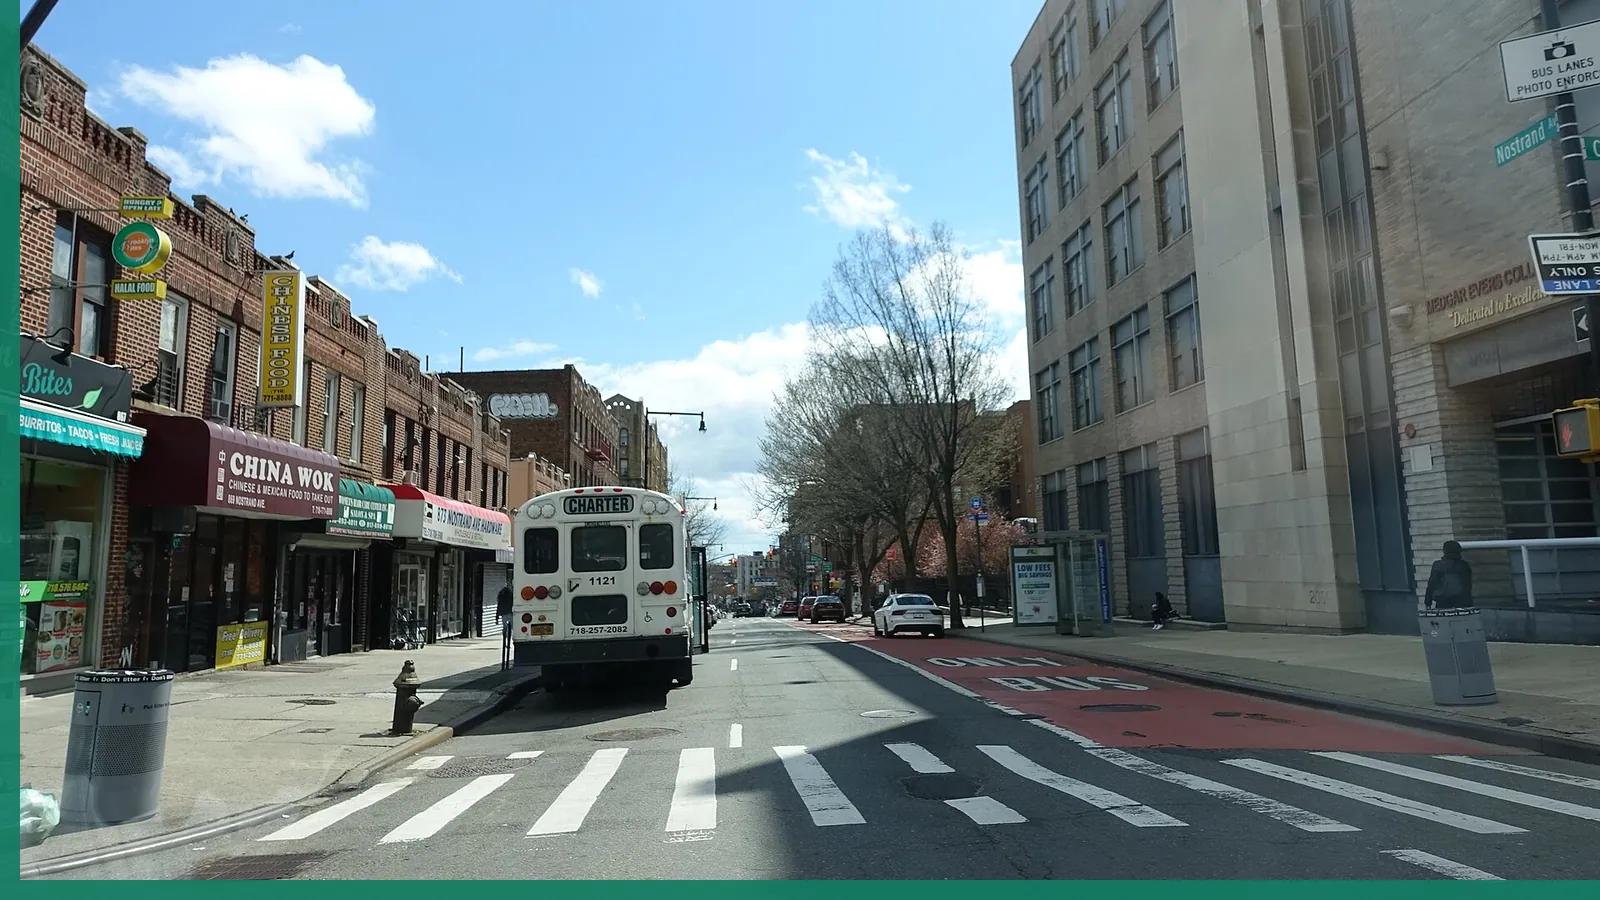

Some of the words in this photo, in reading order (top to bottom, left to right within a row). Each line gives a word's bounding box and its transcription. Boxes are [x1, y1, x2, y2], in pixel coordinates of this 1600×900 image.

[1532, 66, 1553, 79] BUS
[1557, 57, 1595, 74] LANES
[1517, 81, 1552, 95] PHOTO
[1556, 70, 1600, 88] ENFORC
[1496, 122, 1546, 164] Nostrand
[1559, 242, 1598, 251] MON-FRI
[1542, 253, 1586, 261] 4PM-7PM
[1550, 266, 1587, 277] ONLY
[114, 283, 136, 293] HALAL
[136, 282, 156, 293] FOOD
[1427, 287, 1467, 315] MEDGAR
[1468, 274, 1504, 300] EVERS
[1503, 261, 1535, 286] COLL
[1553, 280, 1591, 290] LANE
[270, 275, 294, 345] CHINESE
[1495, 299, 1505, 314] to
[268, 348, 291, 389] FOOD
[22, 362, 73, 396] Bites
[20, 414, 62, 434] BURRITOS
[67, 425, 94, 440] TACOS
[100, 432, 120, 446] FRESH
[230, 452, 294, 486] CHINA
[297, 466, 334, 492] WOK
[228, 479, 256, 494] CHINESE
[256, 486, 261, 494] &
[262, 485, 287, 498] MEXICAN
[288, 489, 303, 500] FOOD
[303, 491, 311, 501] TO
[311, 493, 323, 503] TAKE
[324, 495, 334, 504] OUT
[235, 496, 257, 508] NOSTRAND
[568, 497, 629, 513] CHARTER
[447, 509, 472, 529] NOSTRAND
[472, 516, 481, 531] AVE
[481, 519, 503, 535] HARDWARE
[1017, 564, 1033, 572] LOW
[1029, 571, 1052, 579] SAVINGS
[589, 576, 616, 586] 1121
[570, 626, 628, 635] 718-257-2082
[926, 656, 1067, 667] ONLY
[988, 676, 1149, 691] BUS
